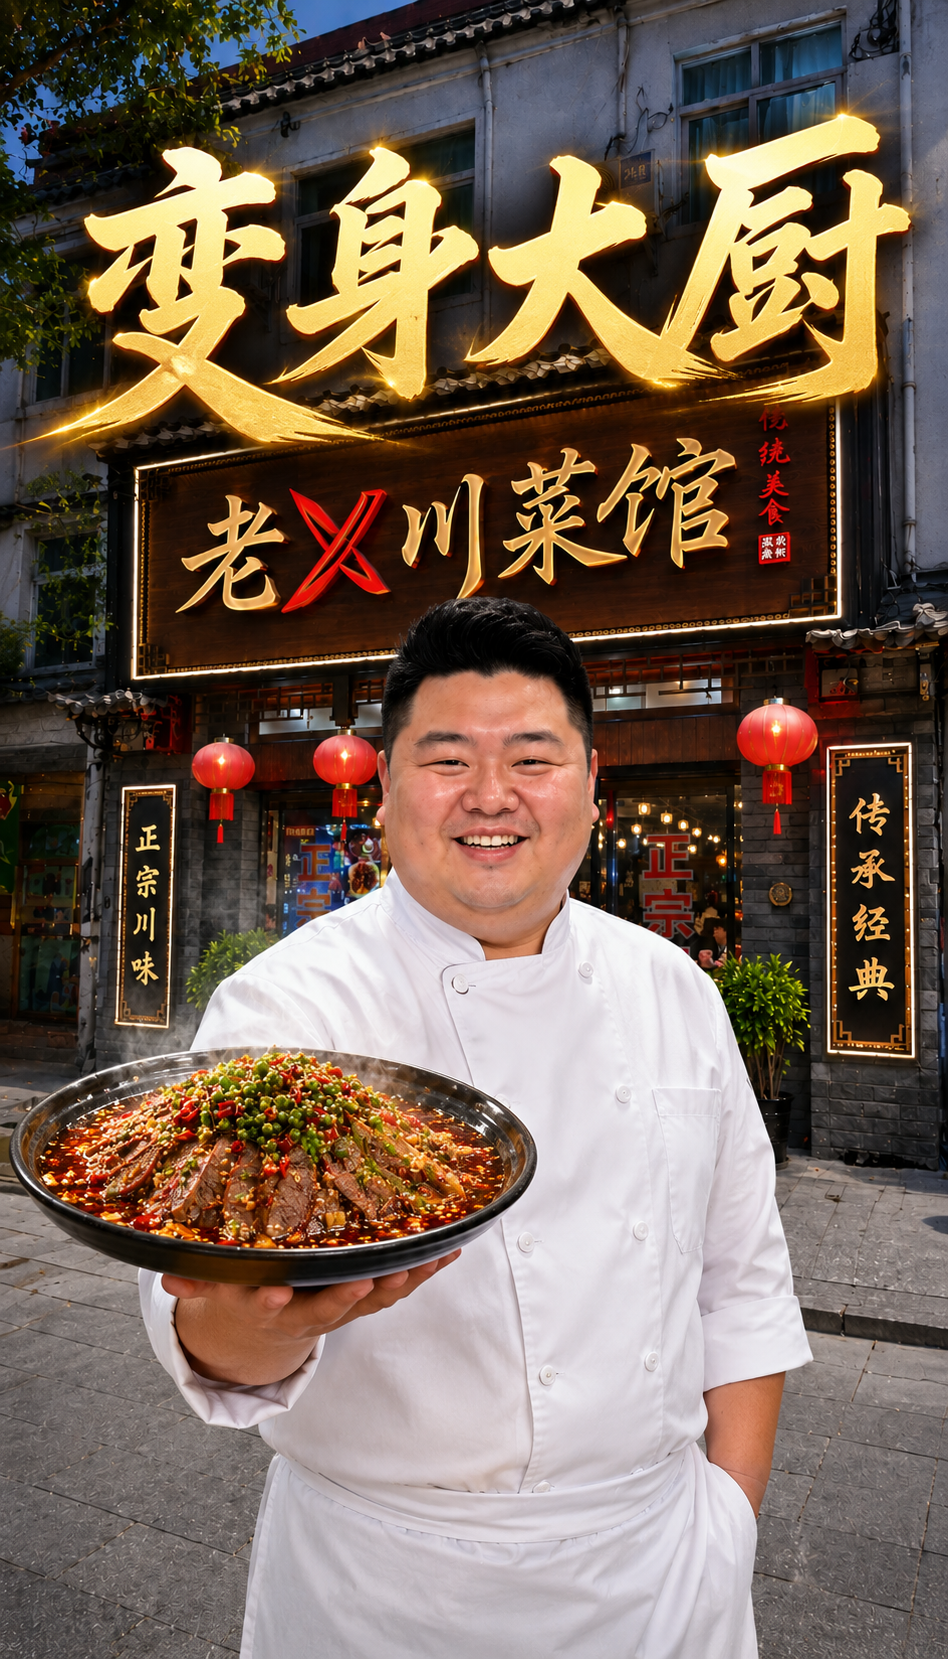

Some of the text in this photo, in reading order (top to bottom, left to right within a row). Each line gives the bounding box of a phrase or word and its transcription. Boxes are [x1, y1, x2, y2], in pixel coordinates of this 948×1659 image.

[131, 824, 161, 986] 正宗川味
[642, 833, 694, 957] 正宗
[848, 793, 896, 1001] 传承经典
